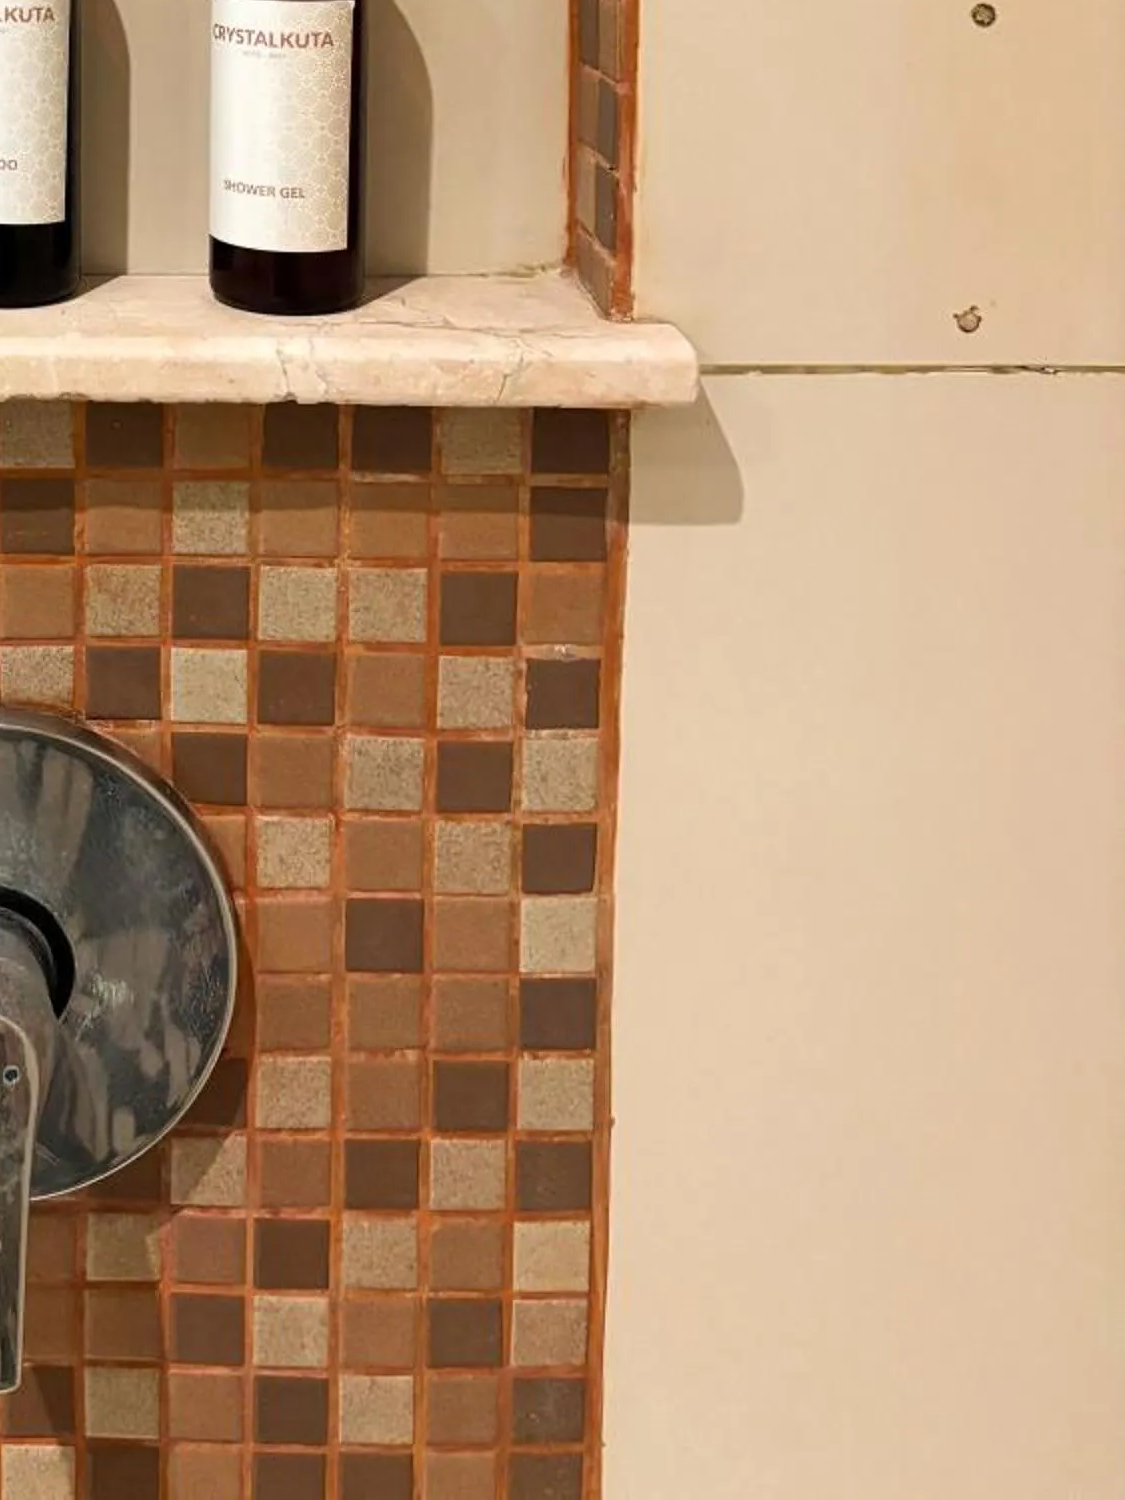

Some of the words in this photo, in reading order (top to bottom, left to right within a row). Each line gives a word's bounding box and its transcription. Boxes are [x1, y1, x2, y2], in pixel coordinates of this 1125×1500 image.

[213, 23, 335, 48] CRYSTALKUTA
[223, 179, 276, 198] SHOWER
[279, 186, 306, 199] GEL
